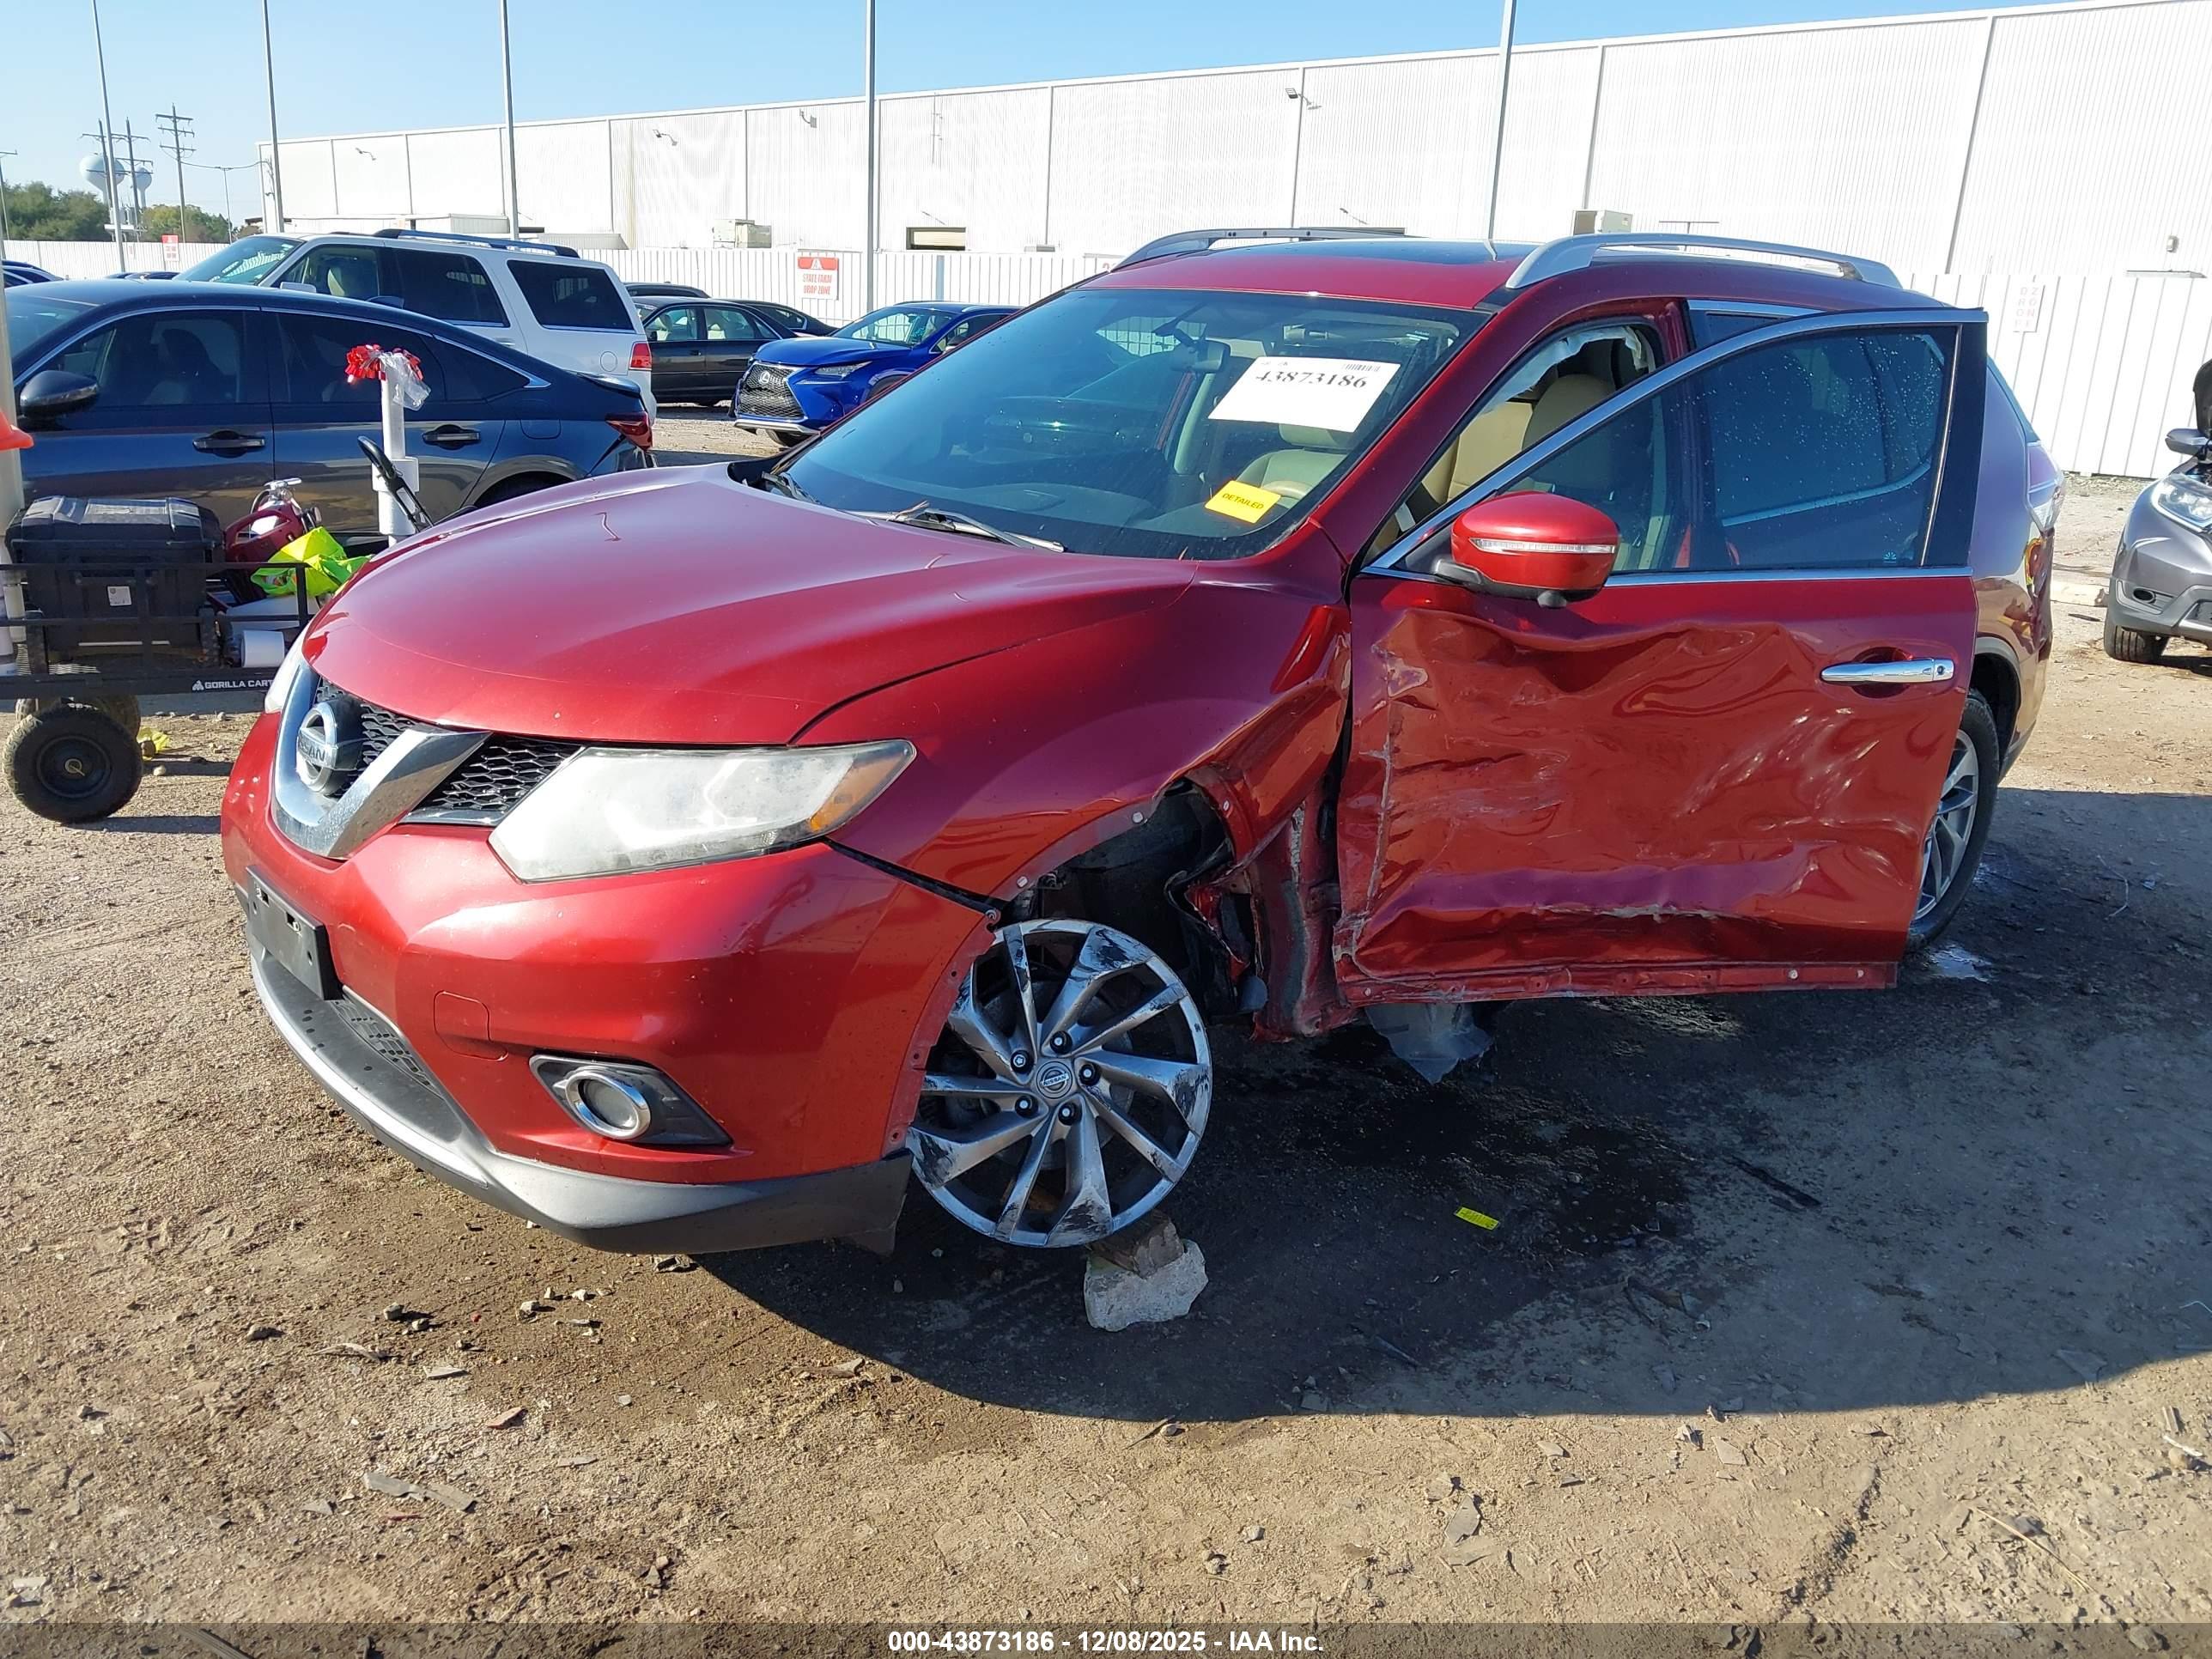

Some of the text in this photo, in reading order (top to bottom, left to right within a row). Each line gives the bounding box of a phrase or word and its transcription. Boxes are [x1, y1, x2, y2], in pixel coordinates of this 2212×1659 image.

[803, 273, 817, 283] STATE
[804, 285, 830, 295] DROP ZONE
[1255, 371, 1367, 387] 43873186
[1222, 493, 1264, 509] DETAILED
[204, 680, 246, 689] GORILLA
[1043, 1075, 1066, 1085] NISSAN
